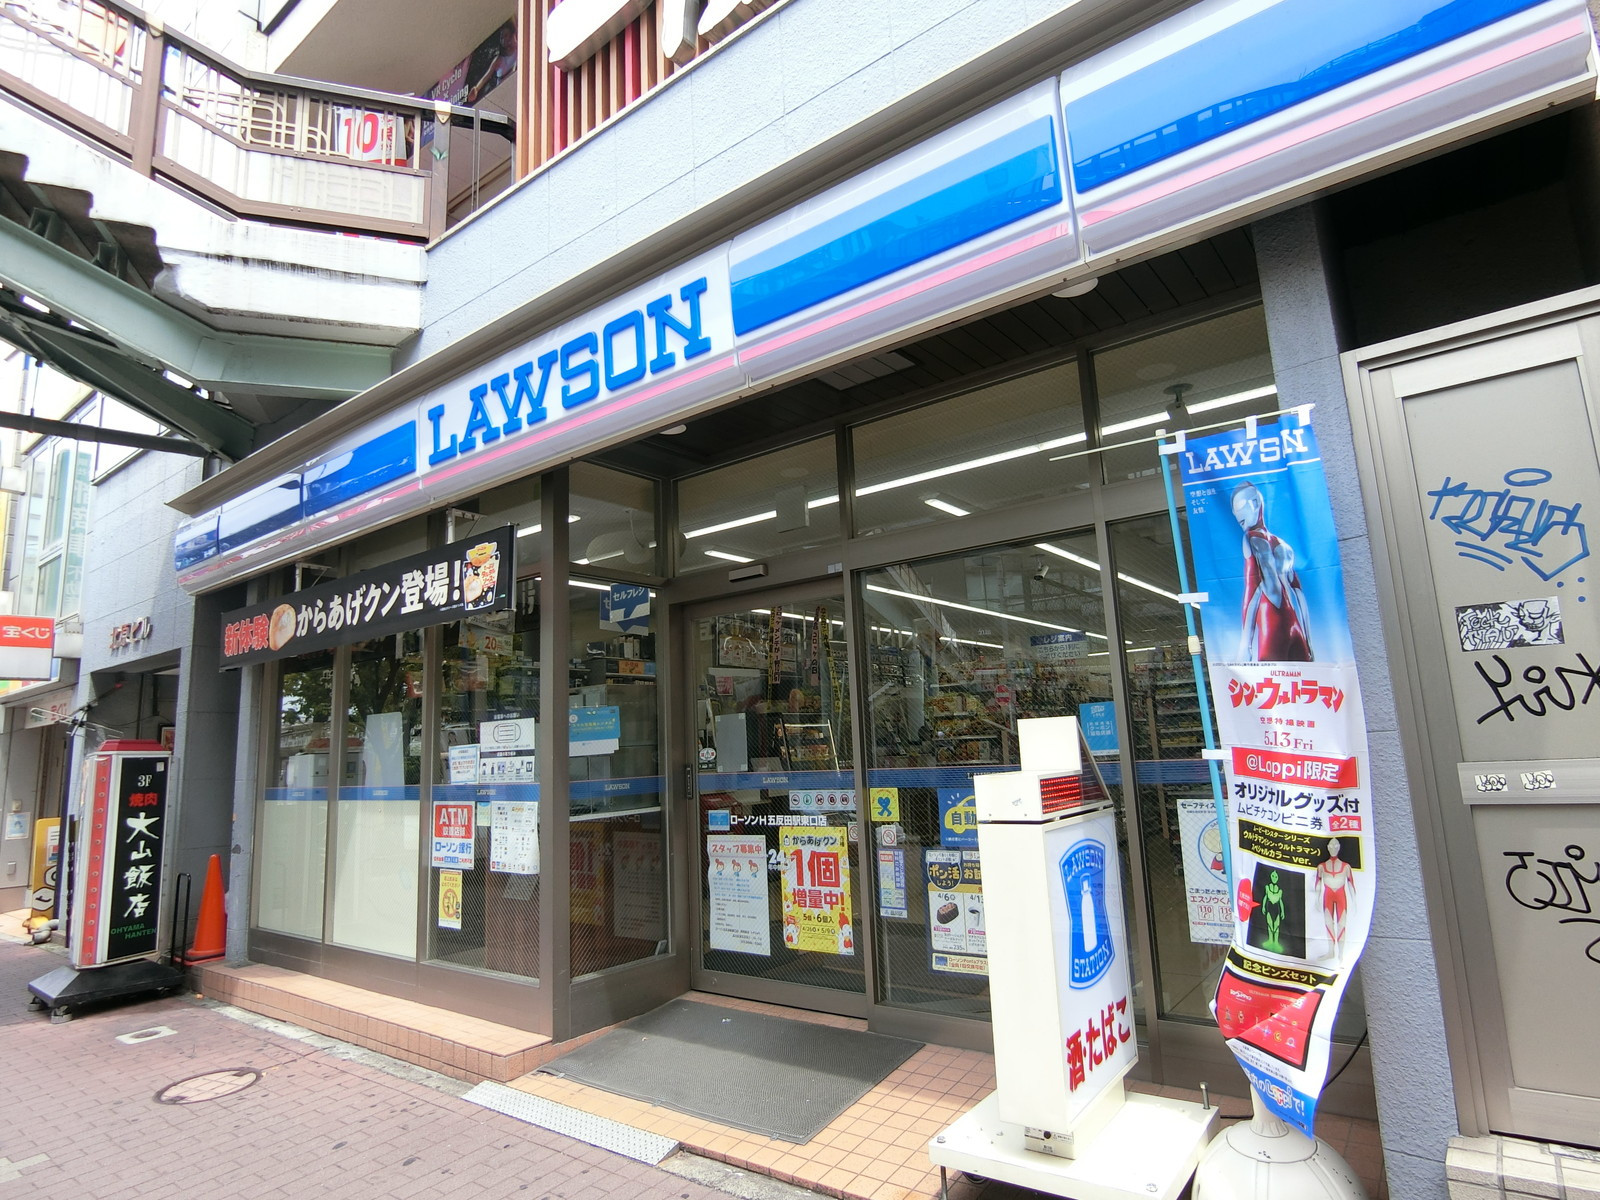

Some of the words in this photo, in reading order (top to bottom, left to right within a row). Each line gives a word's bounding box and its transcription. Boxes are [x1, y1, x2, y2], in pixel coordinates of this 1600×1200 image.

[428, 277, 711, 466] LAWSON
[1185, 428, 1309, 475] LAWSN
[612, 586, 645, 602] セルフレジ
[223, 612, 270, 657] 新体験
[296, 559, 462, 638] からあげクン登場!
[2, 624, 51, 640] 宝くじ
[1259, 716, 1315, 728] 空想特撮映画
[1264, 731, 1291, 748] 5.13
[1294, 738, 1313, 750] Fri
[1246, 754, 1340, 783] @Loppi限定
[137, 774, 153, 787] 3F
[1234, 782, 1360, 814] オリジナルグッズ付
[439, 807, 468, 826] ATM
[1237, 802, 1323, 831] ムビチケコンビニ券
[1331, 816, 1360, 830] 全2種
[434, 842, 472, 855] ローソン銀行
[712, 844, 762, 855] スタッフ募集中
[791, 836, 838, 847] からあげクン
[123, 812, 161, 919] 大山飯店
[790, 849, 841, 888] 1個
[1064, 849, 1103, 883] LAWSON
[1292, 855, 1312, 865] ver.
[929, 864, 960, 880] ポン活
[791, 887, 846, 912] 増量中!
[1199, 906, 1212, 914] 110
[110, 923, 145, 936] OHYAMA
[125, 928, 157, 940] HANTEN
[1074, 940, 1109, 978] STATION
[1243, 959, 1317, 984] 記念ピンズセット
[1065, 996, 1131, 1093] 酒・たばこ
